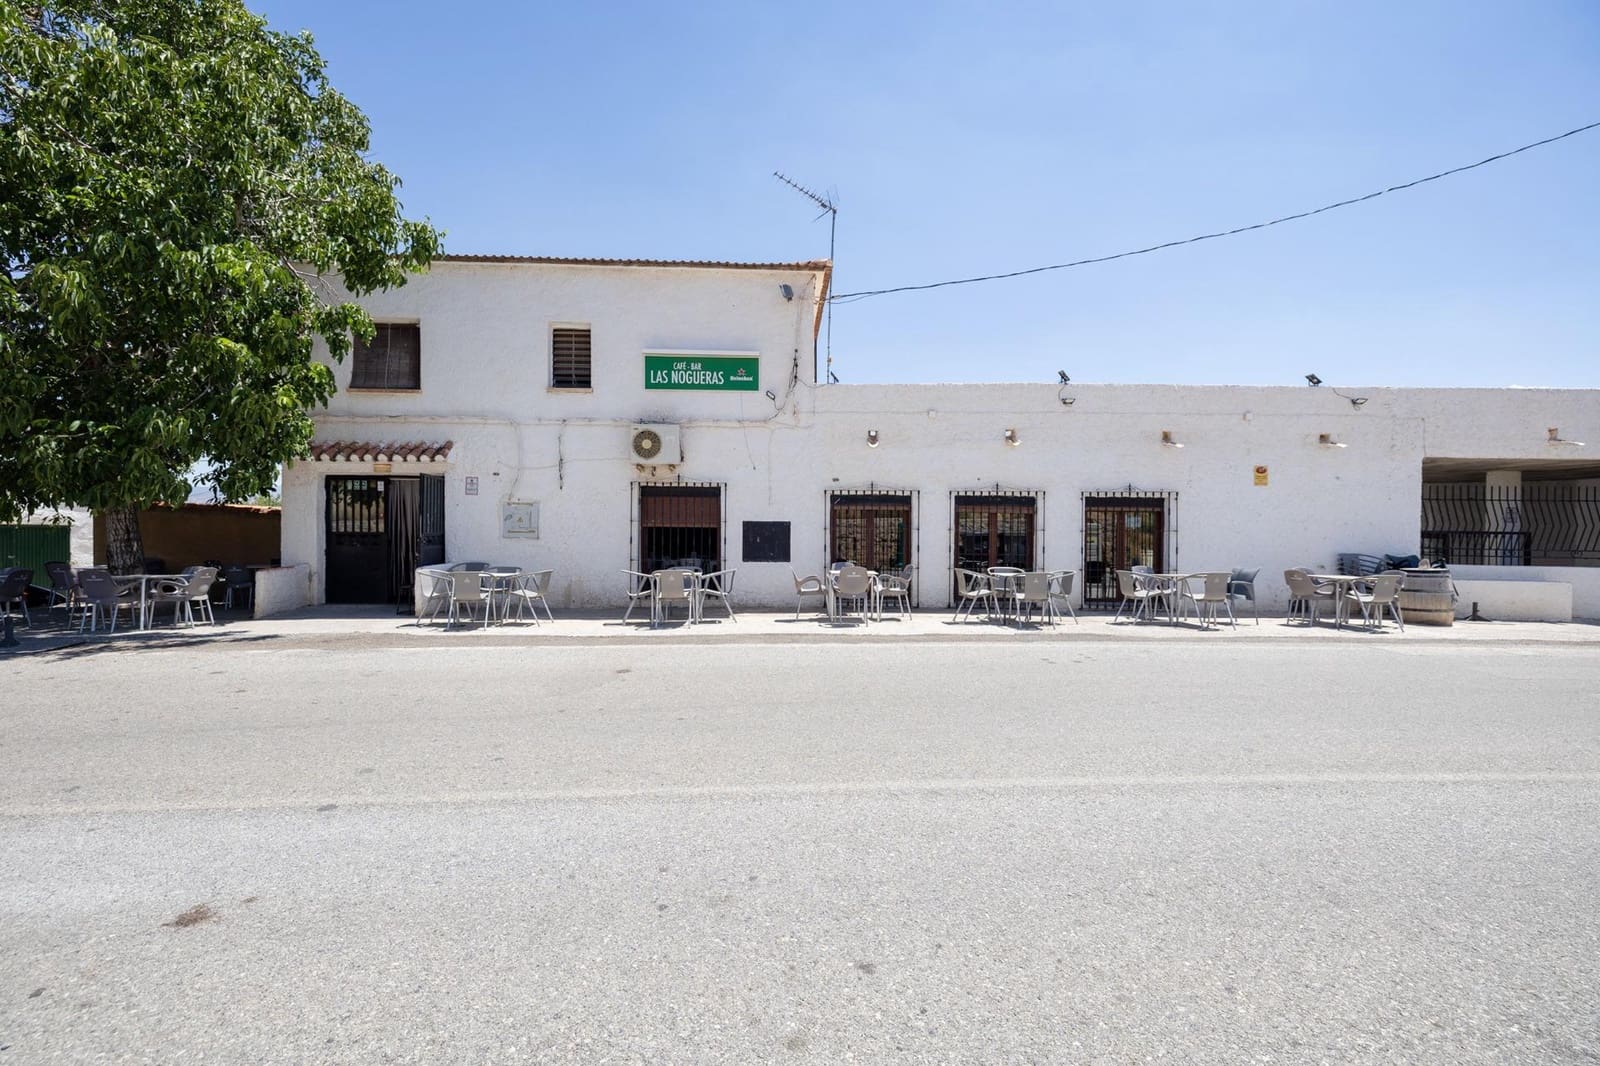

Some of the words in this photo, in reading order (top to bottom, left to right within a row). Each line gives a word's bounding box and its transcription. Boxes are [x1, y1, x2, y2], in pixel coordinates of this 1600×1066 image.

[691, 362, 702, 370] BAR
[650, 370, 668, 384] LAS
[671, 370, 725, 385] NOGUERAS
